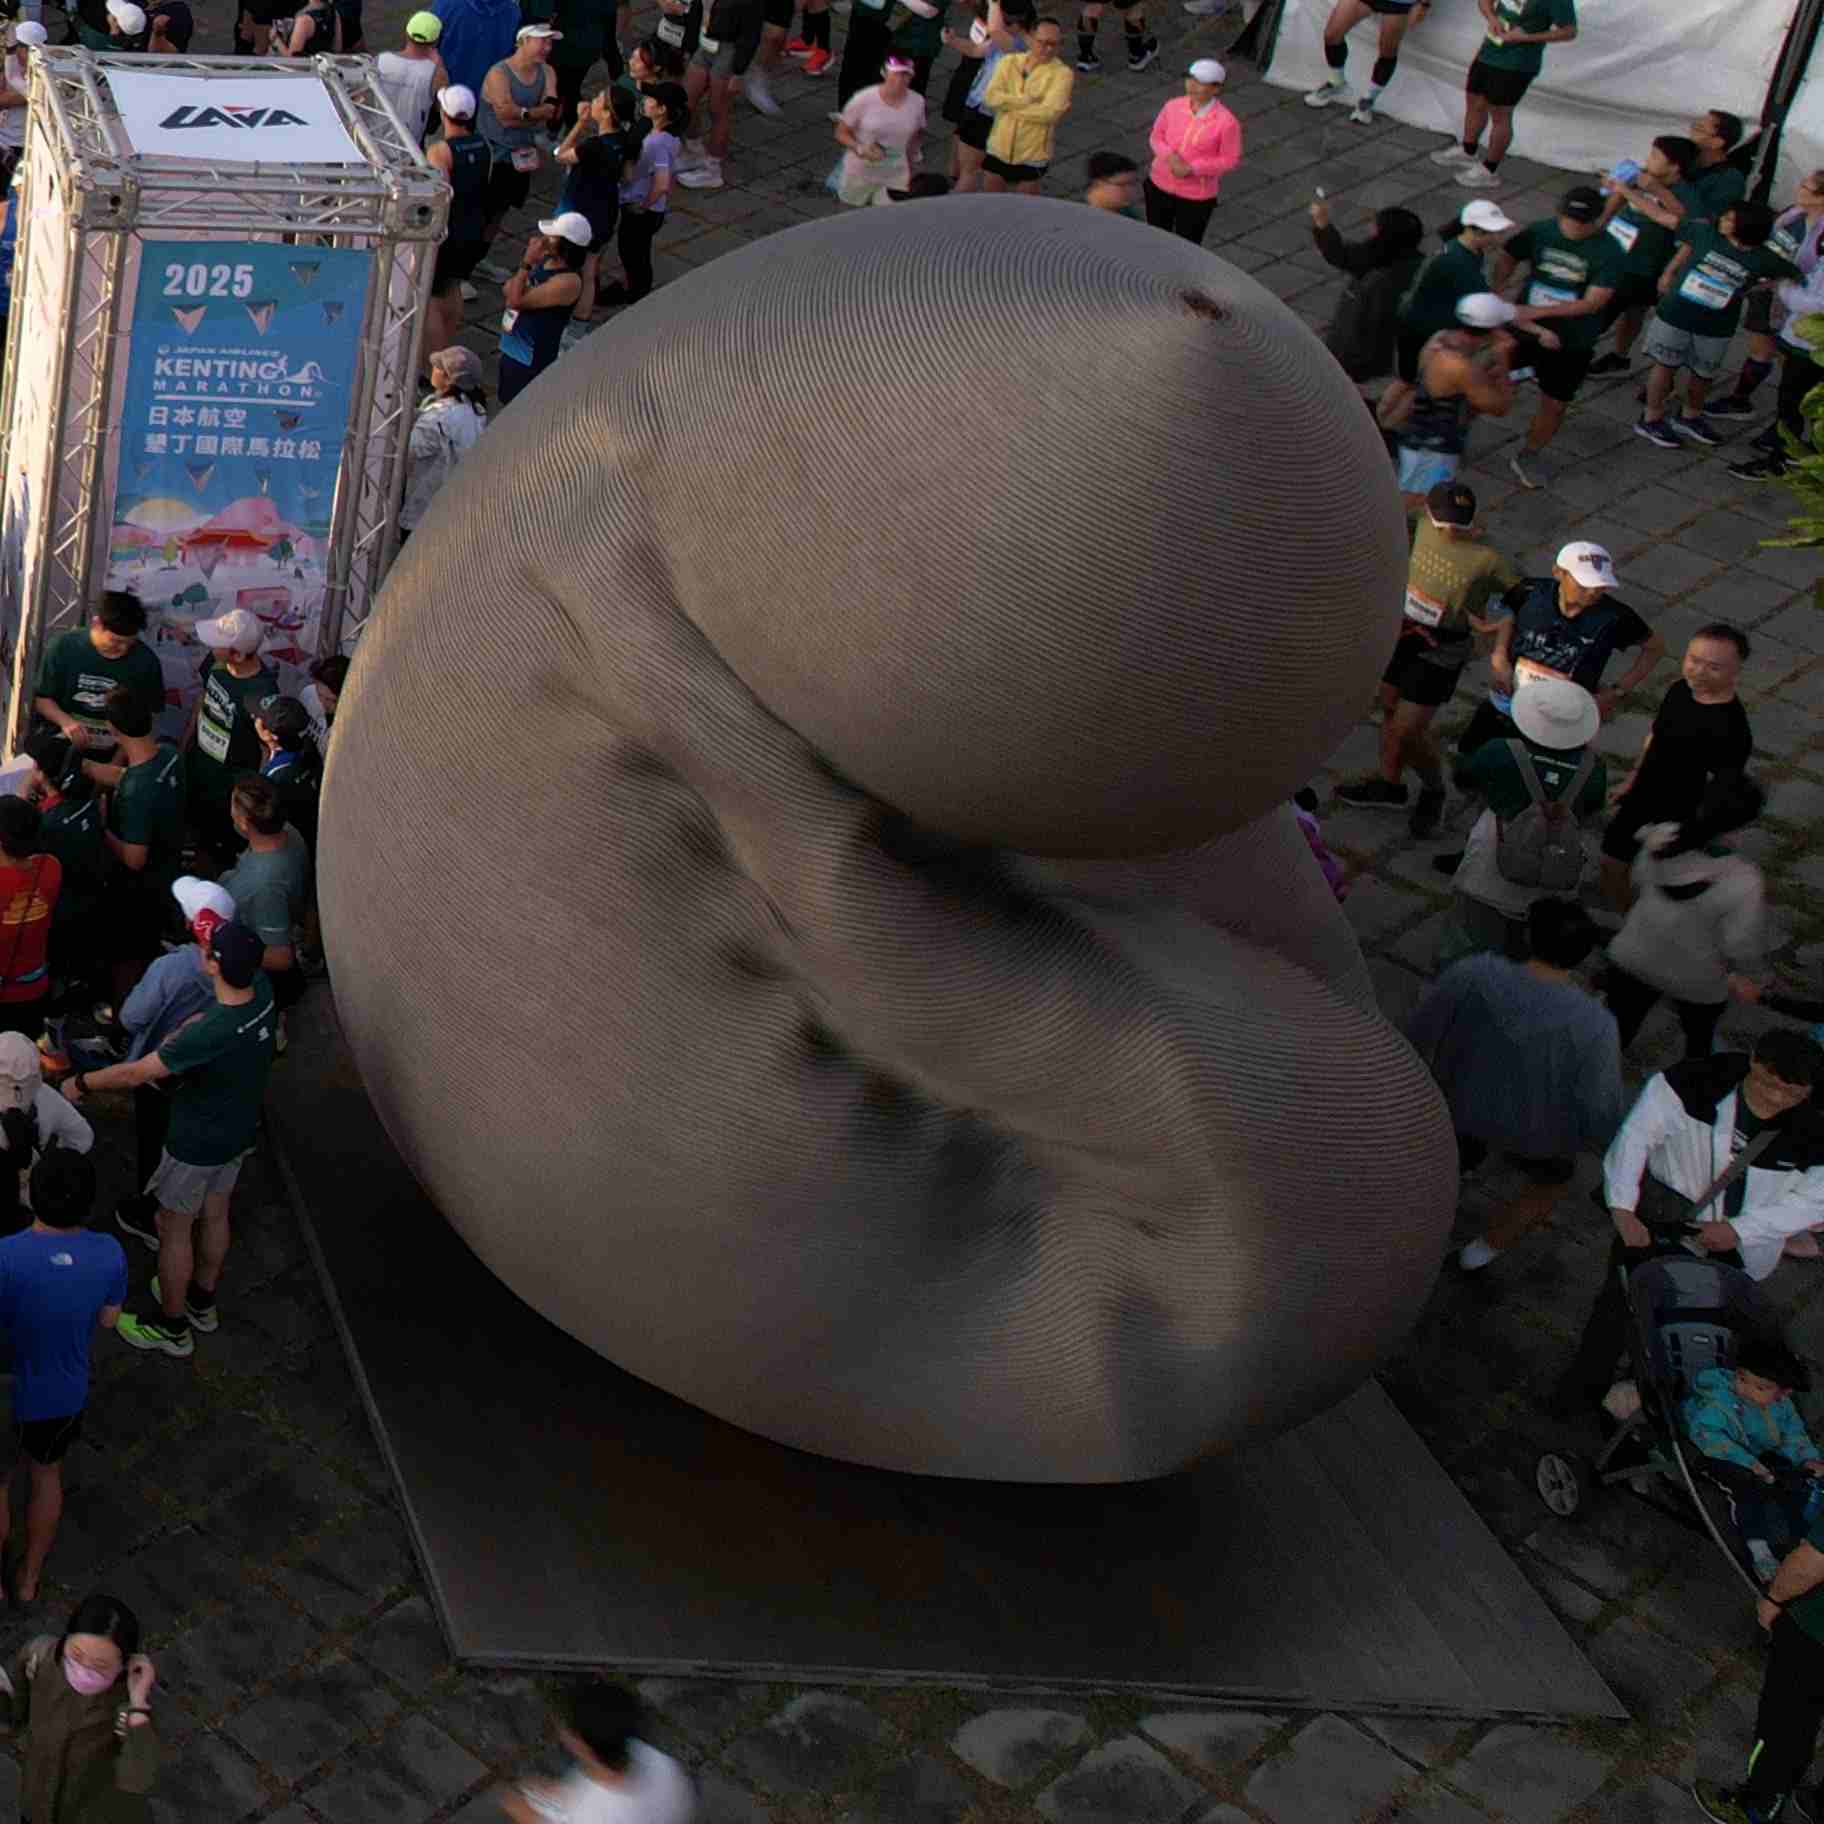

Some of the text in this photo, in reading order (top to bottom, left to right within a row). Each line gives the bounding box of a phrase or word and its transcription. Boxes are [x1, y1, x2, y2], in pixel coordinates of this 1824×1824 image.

[159, 106, 310, 129] LAVA
[163, 264, 254, 298] 2025
[154, 358, 286, 380] KENTING
[153, 379, 313, 397] MARATHON
[148, 405, 247, 428] 日本航空
[143, 432, 321, 460] 墾丁國際馬拉松
